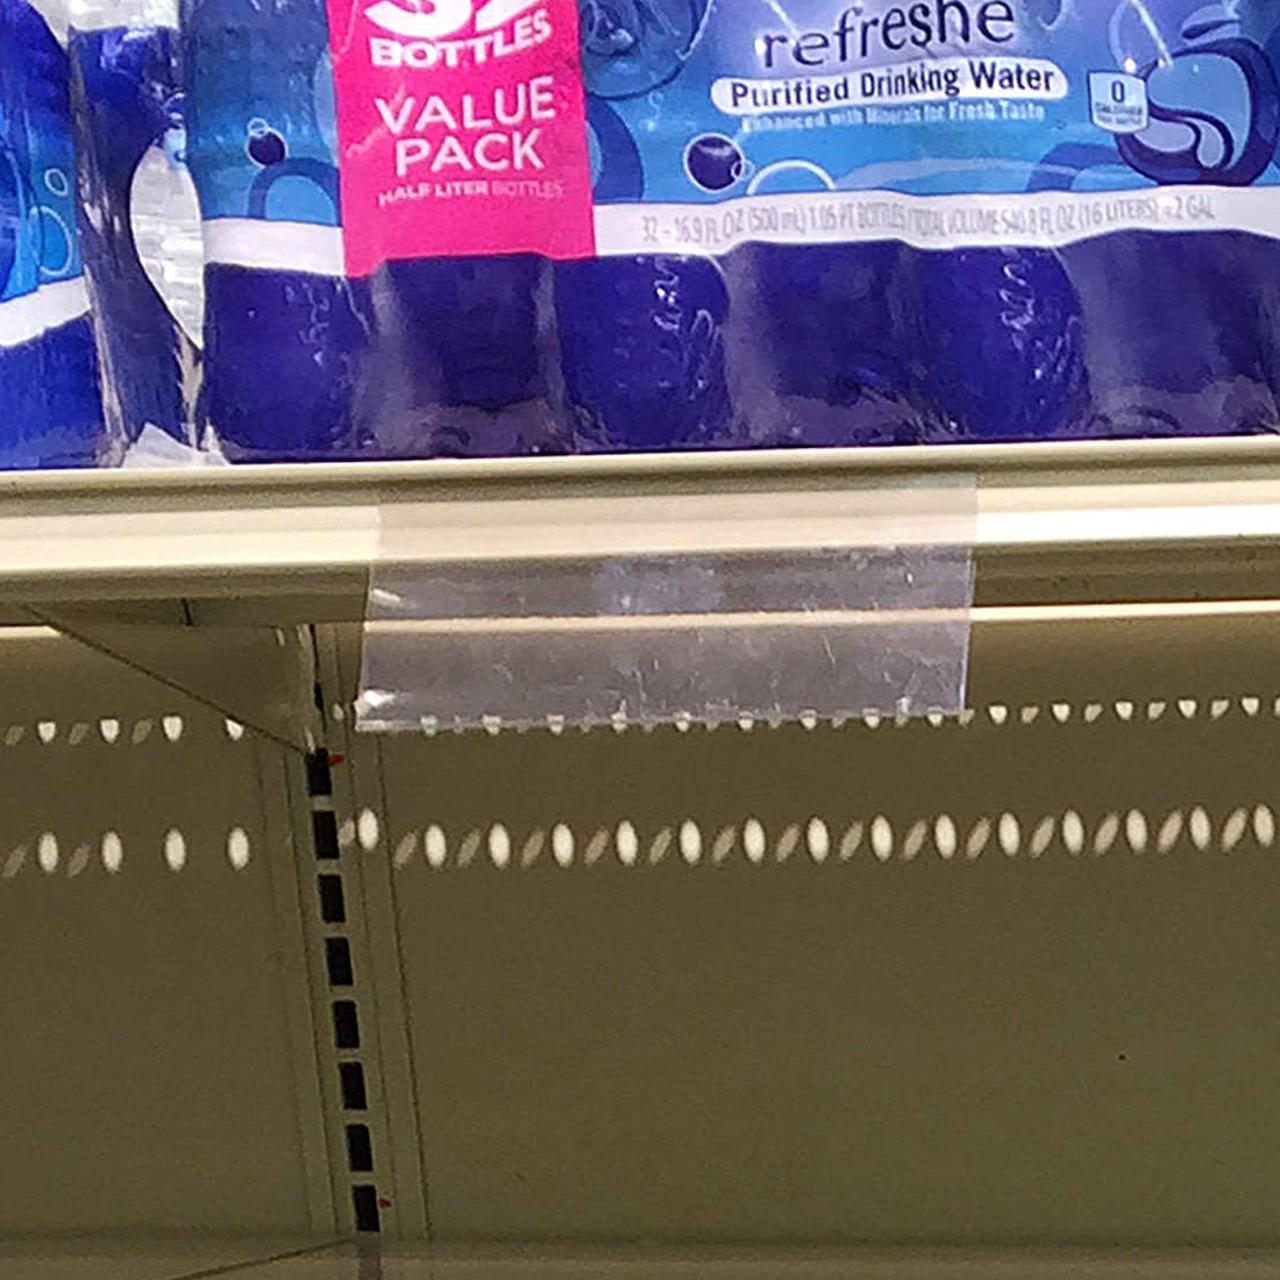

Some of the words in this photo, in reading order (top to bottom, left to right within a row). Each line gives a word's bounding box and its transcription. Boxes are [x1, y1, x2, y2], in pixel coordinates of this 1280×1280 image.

[369, 9, 552, 68] BOTTLES
[763, 0, 1015, 68] refreshe
[374, 75, 556, 135] VALUE
[731, 78, 849, 108] Purified
[860, 63, 961, 98] Drinking
[968, 61, 1055, 91] Water
[1112, 80, 1125, 103] 0
[949, 101, 998, 122] Fresh
[395, 128, 545, 178] PACK
[378, 182, 430, 208] HALF
[435, 180, 489, 198] LITER
[491, 179, 565, 199] BOTTLES
